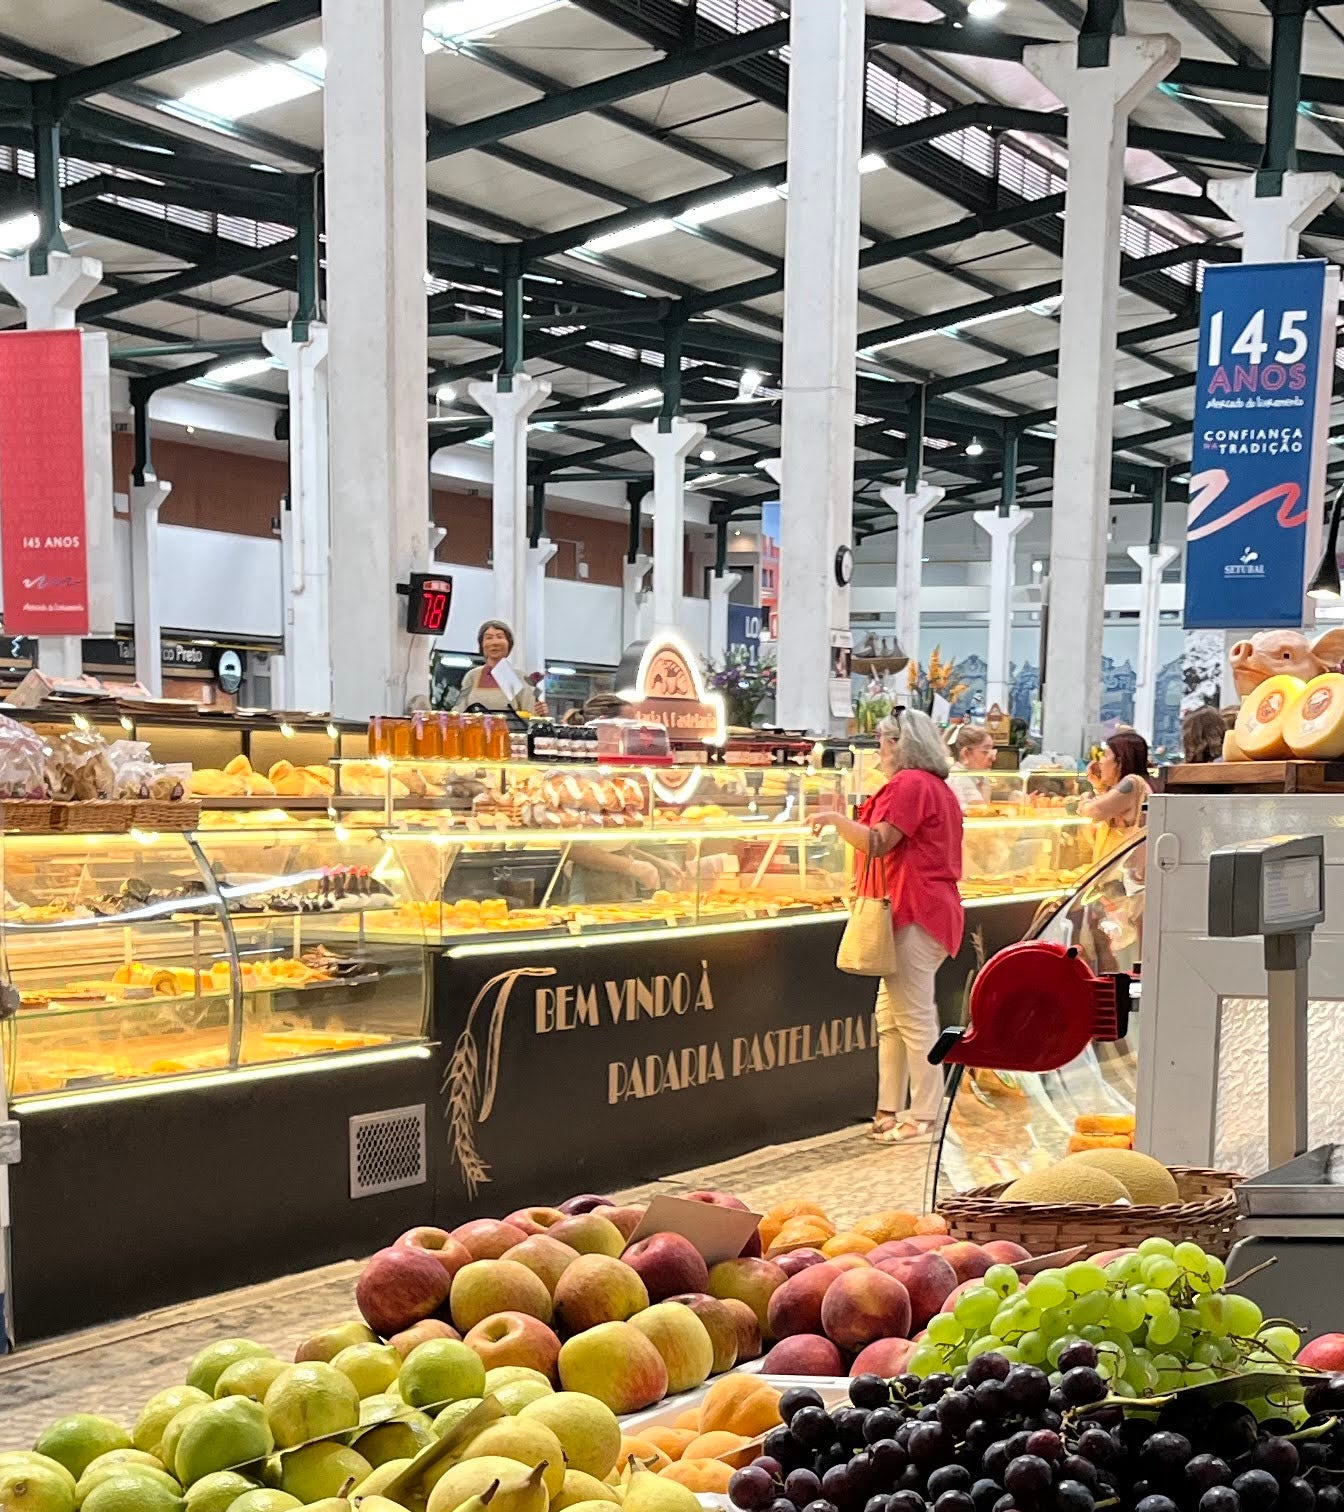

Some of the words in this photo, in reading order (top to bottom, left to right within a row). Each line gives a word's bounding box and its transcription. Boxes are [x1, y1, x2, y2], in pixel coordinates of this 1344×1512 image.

[1207, 309, 1309, 367] 145
[1207, 364, 1307, 394] ANOS
[1203, 428, 1303, 443] CONFIANÇA
[1219, 439, 1303, 455] TRADIÇÃO
[23, 537, 41, 548] 145
[44, 536, 80, 548] ANOS
[423, 593, 446, 629] 78
[175, 644, 203, 663] Preto
[534, 984, 599, 1035] BEM
[607, 971, 692, 1022] VINDO
[694, 959, 714, 1011] À
[607, 1040, 725, 1105] PADARIA
[732, 1015, 867, 1078] PASTELARIA
